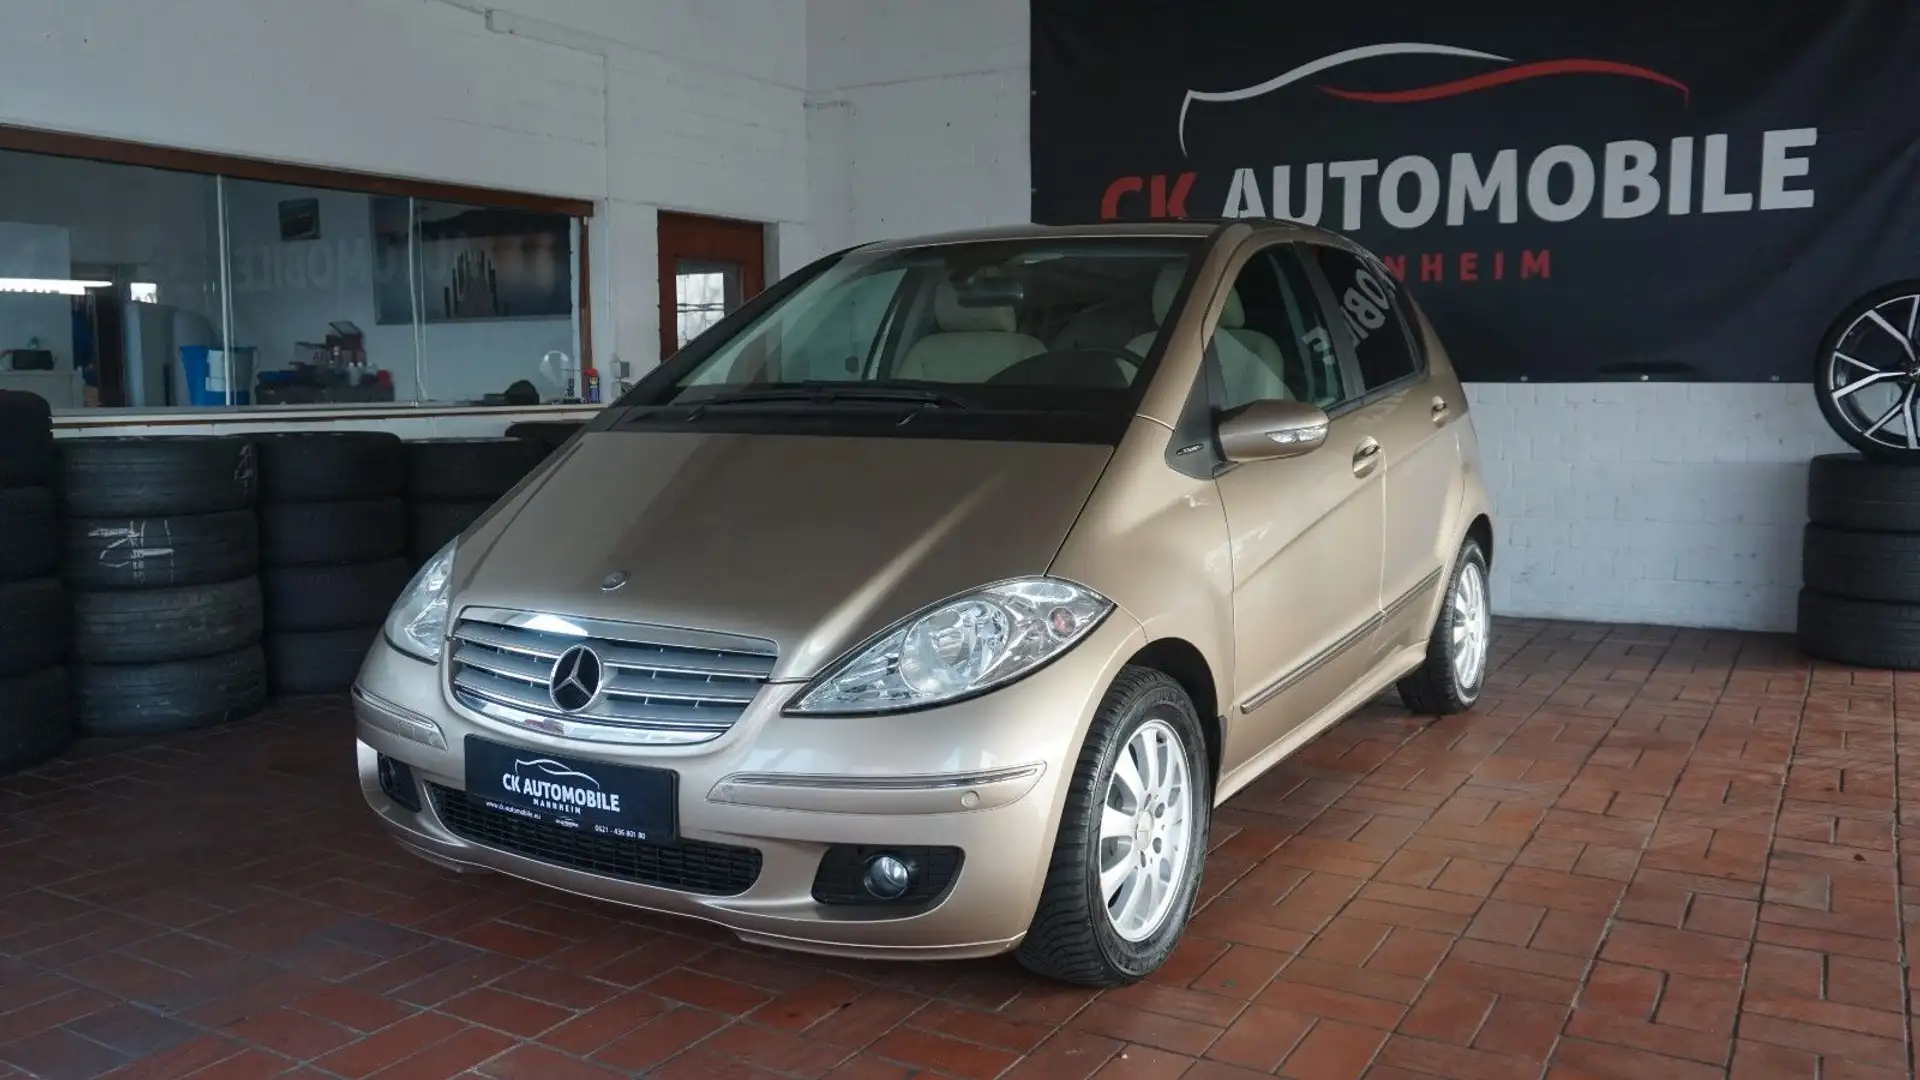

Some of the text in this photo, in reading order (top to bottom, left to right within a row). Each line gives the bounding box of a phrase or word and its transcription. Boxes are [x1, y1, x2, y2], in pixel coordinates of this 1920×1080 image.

[1101, 127, 1818, 231] CK AUTOMOBILE
[502, 773, 620, 812] CK AUTOMOBILE
[533, 798, 580, 814] MANNHEIM
